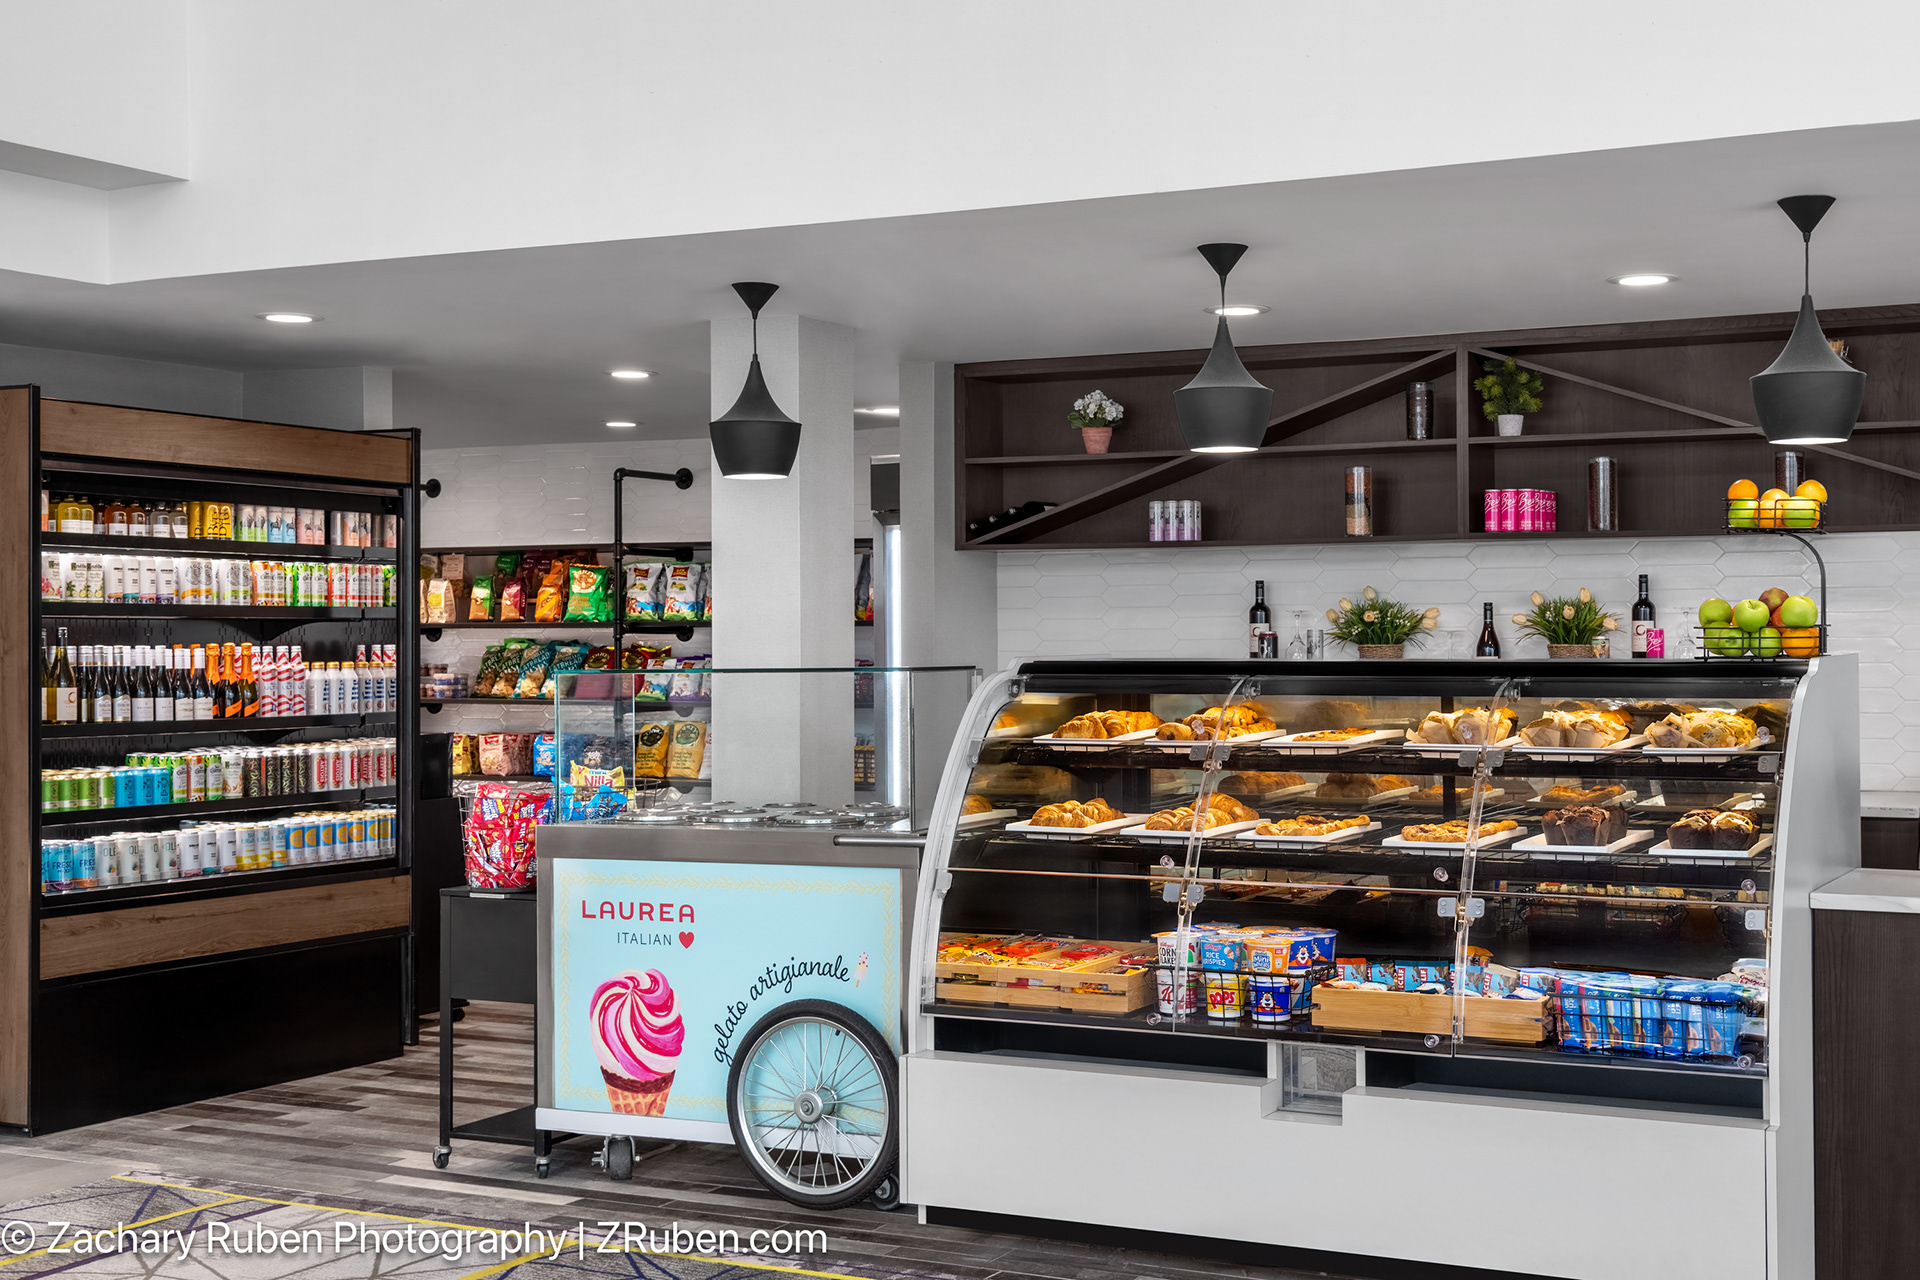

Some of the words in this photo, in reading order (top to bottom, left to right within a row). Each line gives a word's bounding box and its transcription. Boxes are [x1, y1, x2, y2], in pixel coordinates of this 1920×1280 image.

[583, 775, 614, 788] Nilla
[581, 900, 695, 923] LAUREA
[617, 932, 672, 946] ITALIAN
[1205, 951, 1220, 960] RICE
[1209, 990, 1236, 1010] POPS
[714, 1000, 748, 1068] gelato
[750, 955, 850, 1001] artigianale
